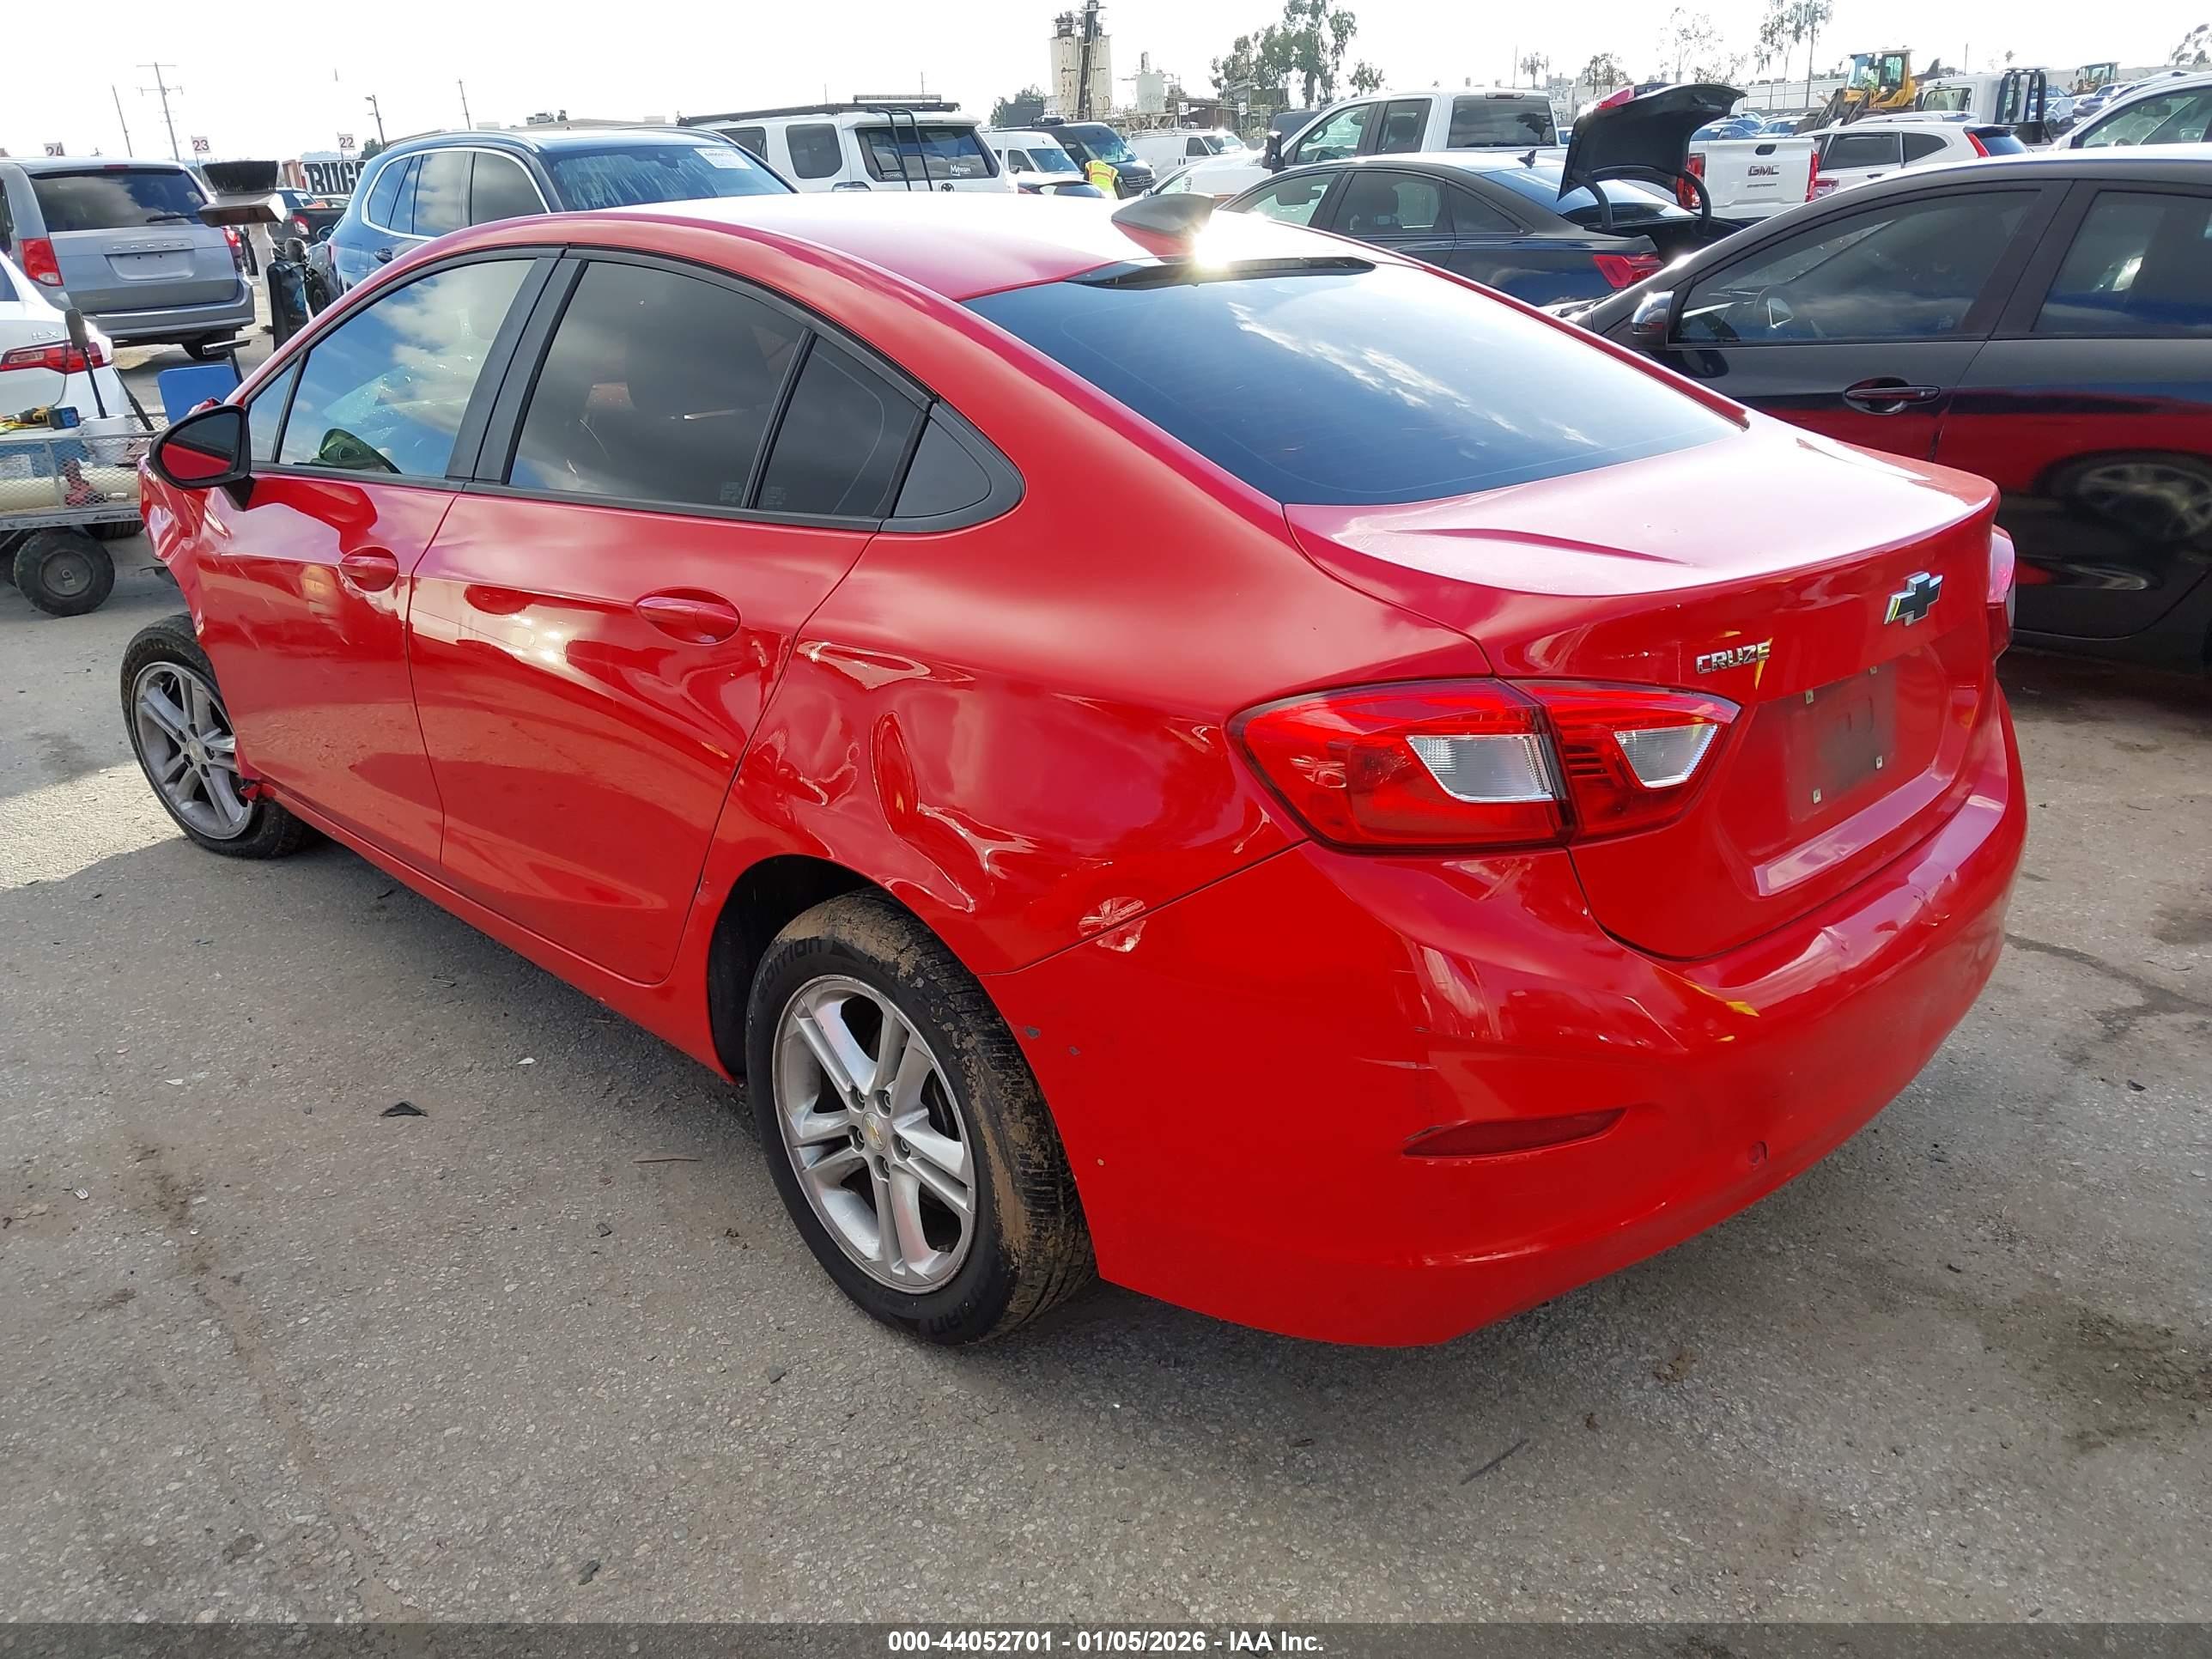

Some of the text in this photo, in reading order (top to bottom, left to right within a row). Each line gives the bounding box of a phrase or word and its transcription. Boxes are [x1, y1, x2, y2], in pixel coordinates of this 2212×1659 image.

[1180, 104, 1188, 112] 13
[192, 139, 210, 151] 23
[338, 137, 355, 149] 22
[46, 146, 66, 157] 24
[1747, 164, 1780, 177] GMC
[31, 331, 58, 340] ILX
[1696, 641, 1771, 674] CRUZE
